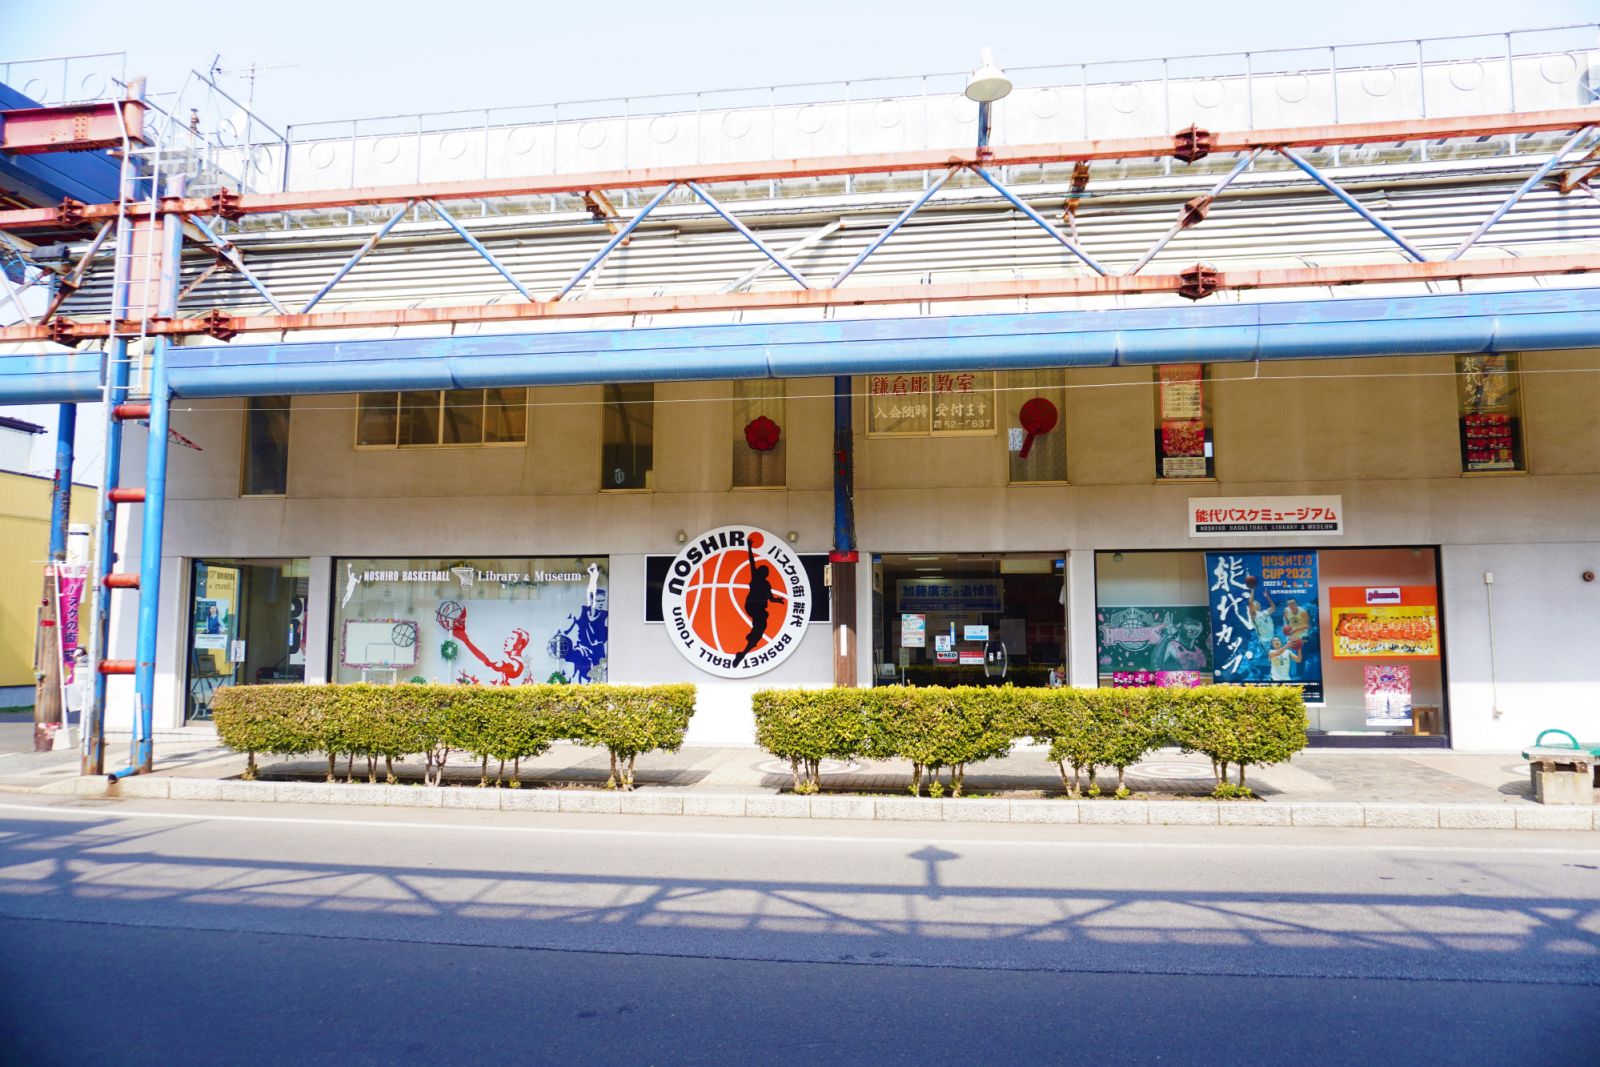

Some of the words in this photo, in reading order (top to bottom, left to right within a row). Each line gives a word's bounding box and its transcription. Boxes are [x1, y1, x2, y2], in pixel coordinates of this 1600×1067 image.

[1195, 507, 1336, 523] 能代バスケミュージアム
[1262, 555, 1312, 567] NOSHIRO
[1262, 568, 1284, 579] CUP
[1285, 568, 1312, 579] 2022
[363, 571, 399, 582] NOSHIRO
[402, 571, 450, 582] BASKETBALL
[478, 571, 520, 583] Library
[535, 571, 582, 582] Museum
[768, 545, 805, 598] バスケの街
[790, 602, 805, 628] 能代
[672, 606, 695, 649] TOWN
[1211, 556, 1255, 677] 能代カップ
[742, 633, 793, 669] BASKET
